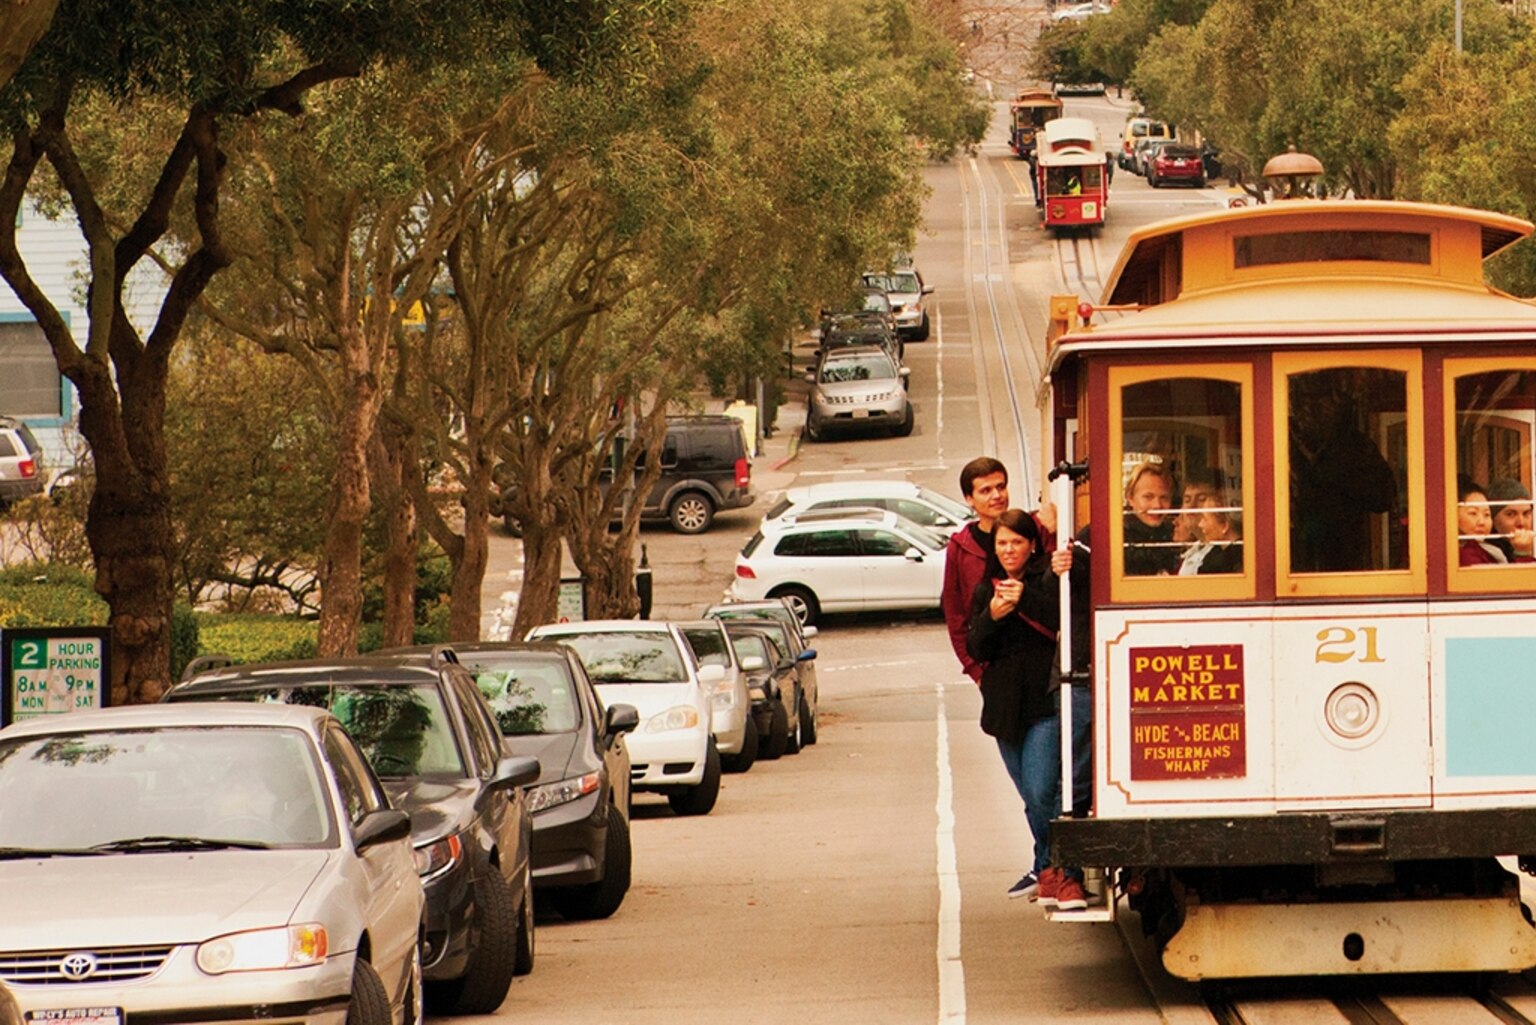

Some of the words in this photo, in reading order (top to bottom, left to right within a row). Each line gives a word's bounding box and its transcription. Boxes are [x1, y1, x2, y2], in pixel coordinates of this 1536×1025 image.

[21, 642, 39, 665] 2
[58, 643, 94, 655] HOUR
[1315, 626, 1386, 664] 21
[49, 658, 100, 669] PARKING
[1135, 654, 1238, 673] POWELL
[1162, 671, 1214, 685] AND
[1133, 683, 1240, 703] MARKET
[22, 697, 44, 708] MON
[75, 696, 94, 707] SAT
[1135, 724, 1170, 743] HYDE
[1193, 722, 1239, 742] BEACH
[1143, 745, 1231, 760] FISHERMANS
[1164, 759, 1210, 772] WHARF
